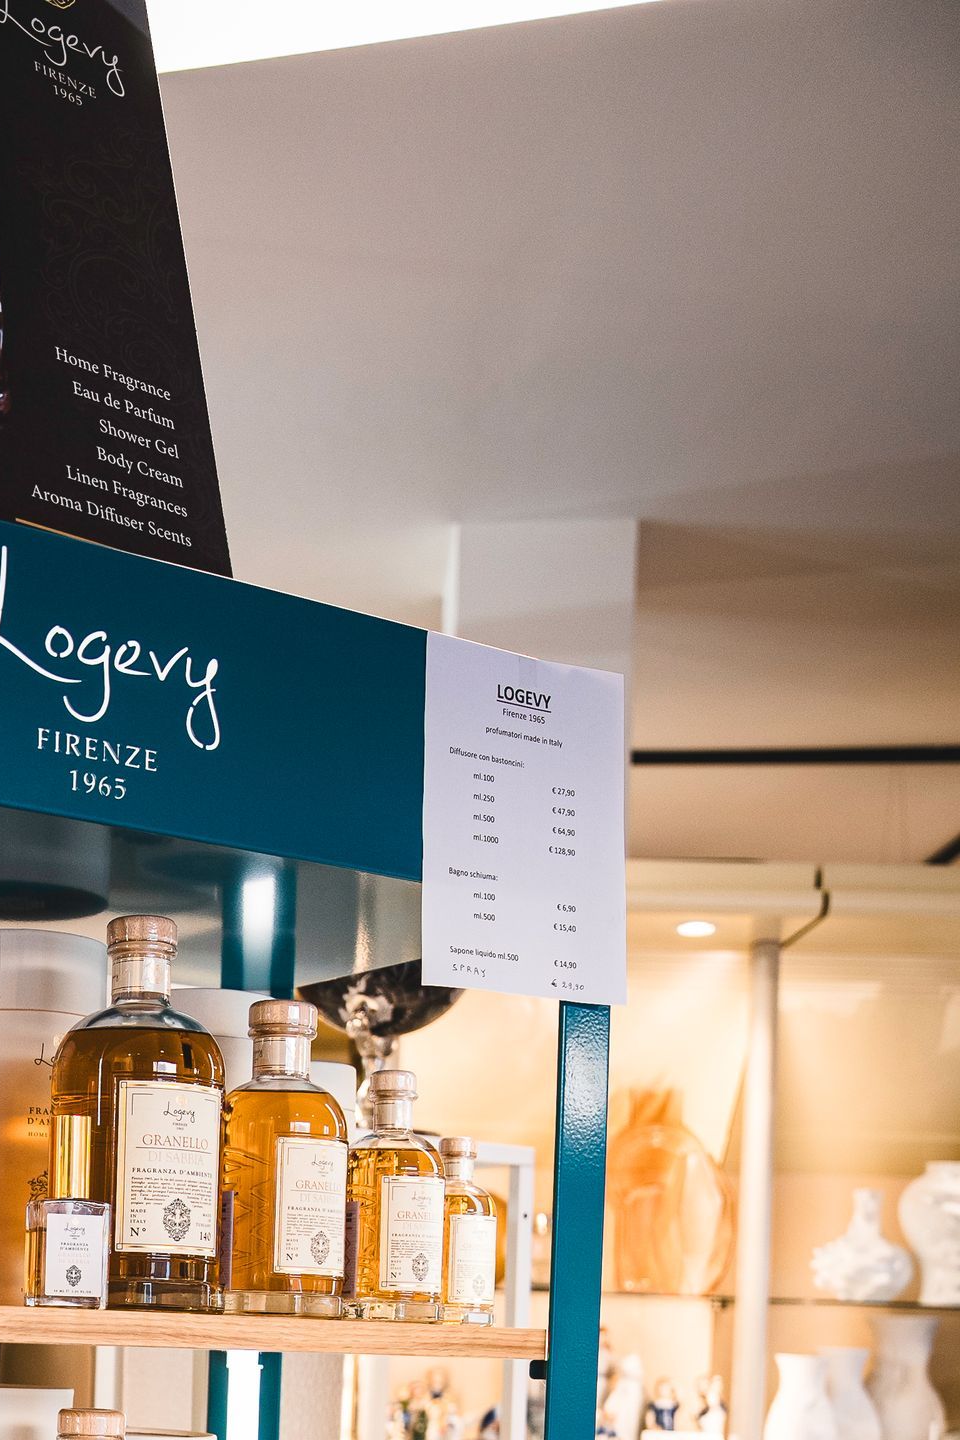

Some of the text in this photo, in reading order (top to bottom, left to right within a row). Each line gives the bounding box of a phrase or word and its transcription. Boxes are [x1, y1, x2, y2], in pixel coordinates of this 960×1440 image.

[34, 61, 97, 99] FIRENZE
[53, 85, 82, 105] 1965
[55, 346, 171, 400] Home Fragrance
[72, 381, 175, 430] Eau de Parfum
[99, 419, 180, 459] Shower Gel
[96, 446, 184, 488] Body Cream
[66, 465, 188, 518] Linen Fragrances
[31, 484, 192, 547] Aroma Diffuser Scents
[497, 684, 551, 709] LOGEVY
[502, 708, 546, 724] Firenze 1965
[485, 726, 563, 748] profumatori made in Italy
[37, 728, 157, 772] FIRENZE
[449, 747, 525, 768] Diffusore con bastoncini:
[69, 769, 126, 800] 1965
[473, 773, 495, 782] ml.100
[473, 793, 495, 803] ml.250
[557, 788, 575, 797] 27,90
[473, 814, 495, 823] ml.500
[557, 808, 575, 817] 47,90
[473, 834, 499, 844] ml.1000
[557, 827, 576, 837] 64,90
[554, 847, 576, 856] 128,90
[448, 867, 499, 881] Bagno schiuma:
[473, 892, 496, 901] ml.100
[473, 913, 496, 921] ml.500
[562, 905, 577, 913] 6,90
[559, 924, 577, 933] 15,40
[449, 946, 519, 962] Sapone liquido ml.500
[559, 960, 577, 969] 14,90
[163, 1101, 197, 1123] Logevy
[142, 1133, 209, 1150] GRANELLO
[148, 1151, 205, 1166] DI SABBIA
[132, 1167, 177, 1175] FRAGRANZA
